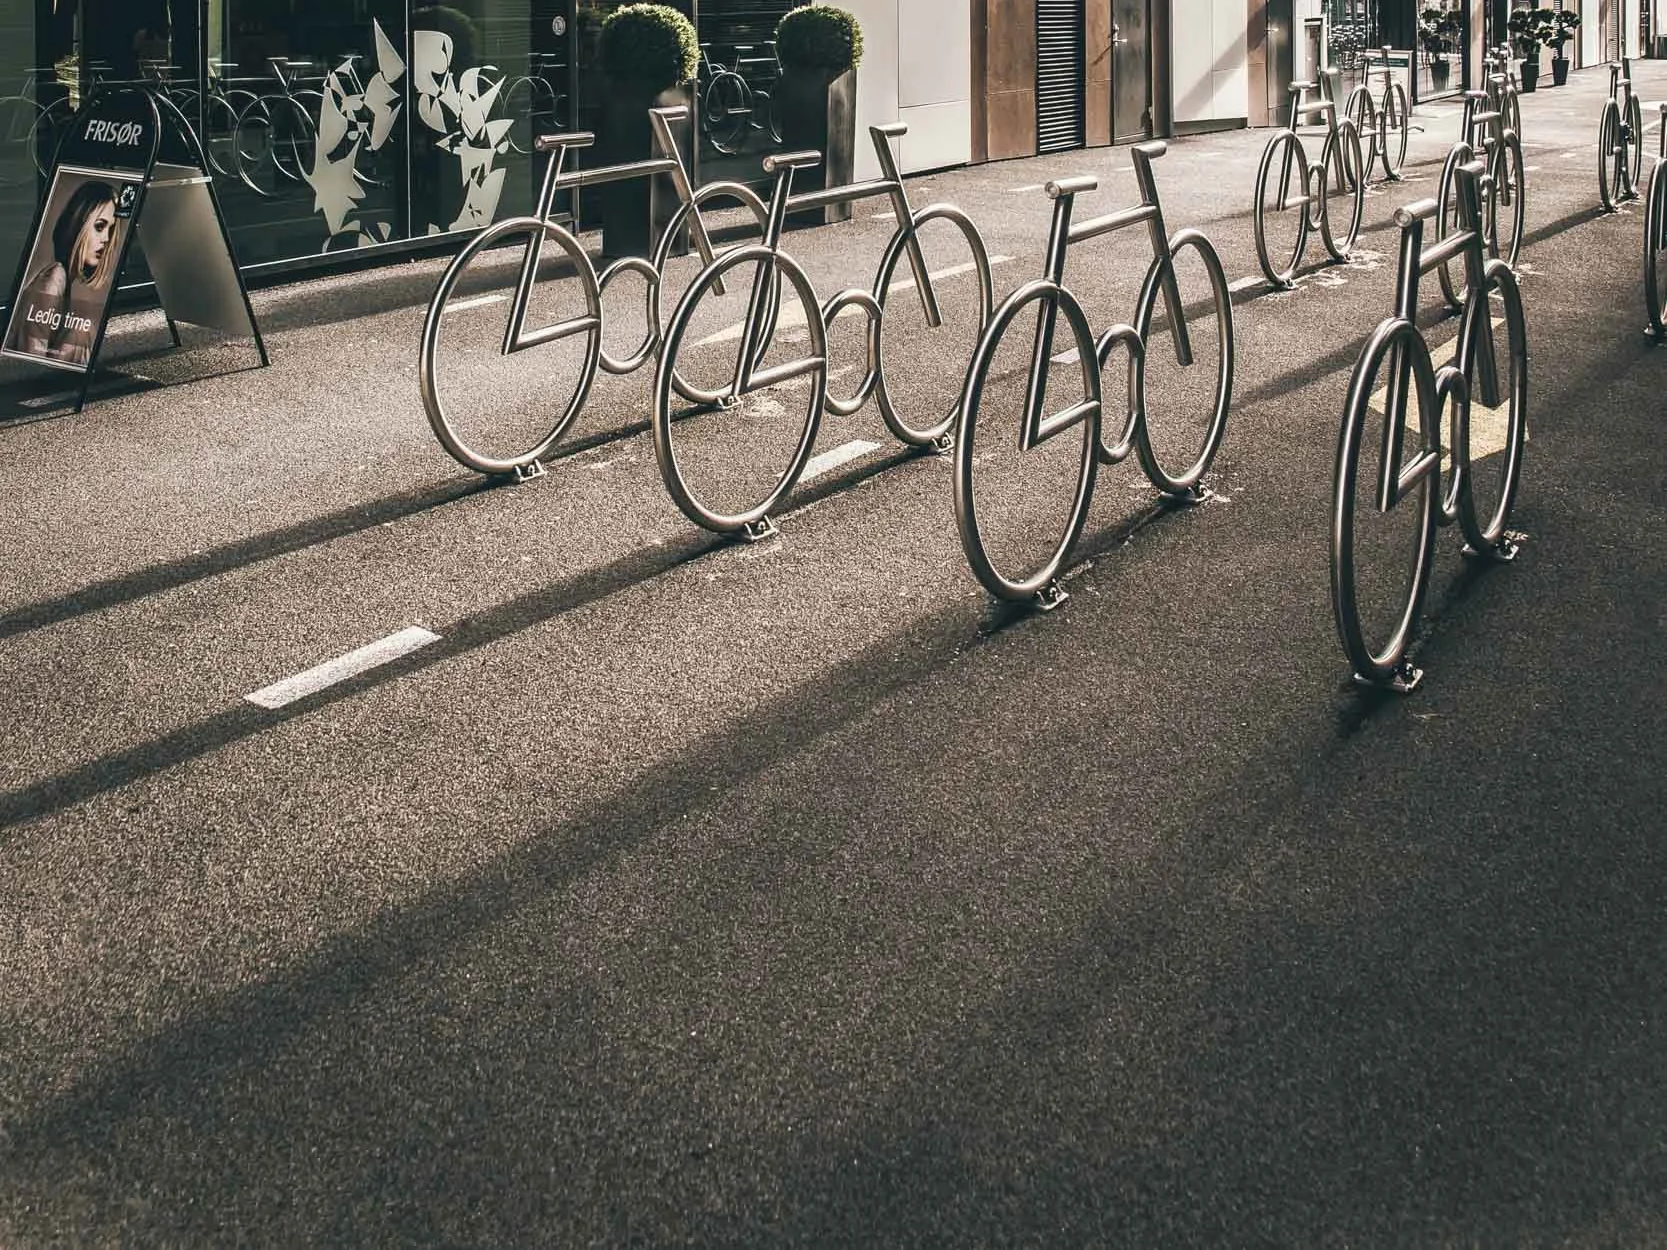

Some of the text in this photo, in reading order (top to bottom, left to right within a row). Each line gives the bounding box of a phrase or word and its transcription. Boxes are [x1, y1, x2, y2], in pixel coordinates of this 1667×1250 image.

[84, 119, 142, 146] FRISØR
[27, 304, 92, 332] Ledig time
